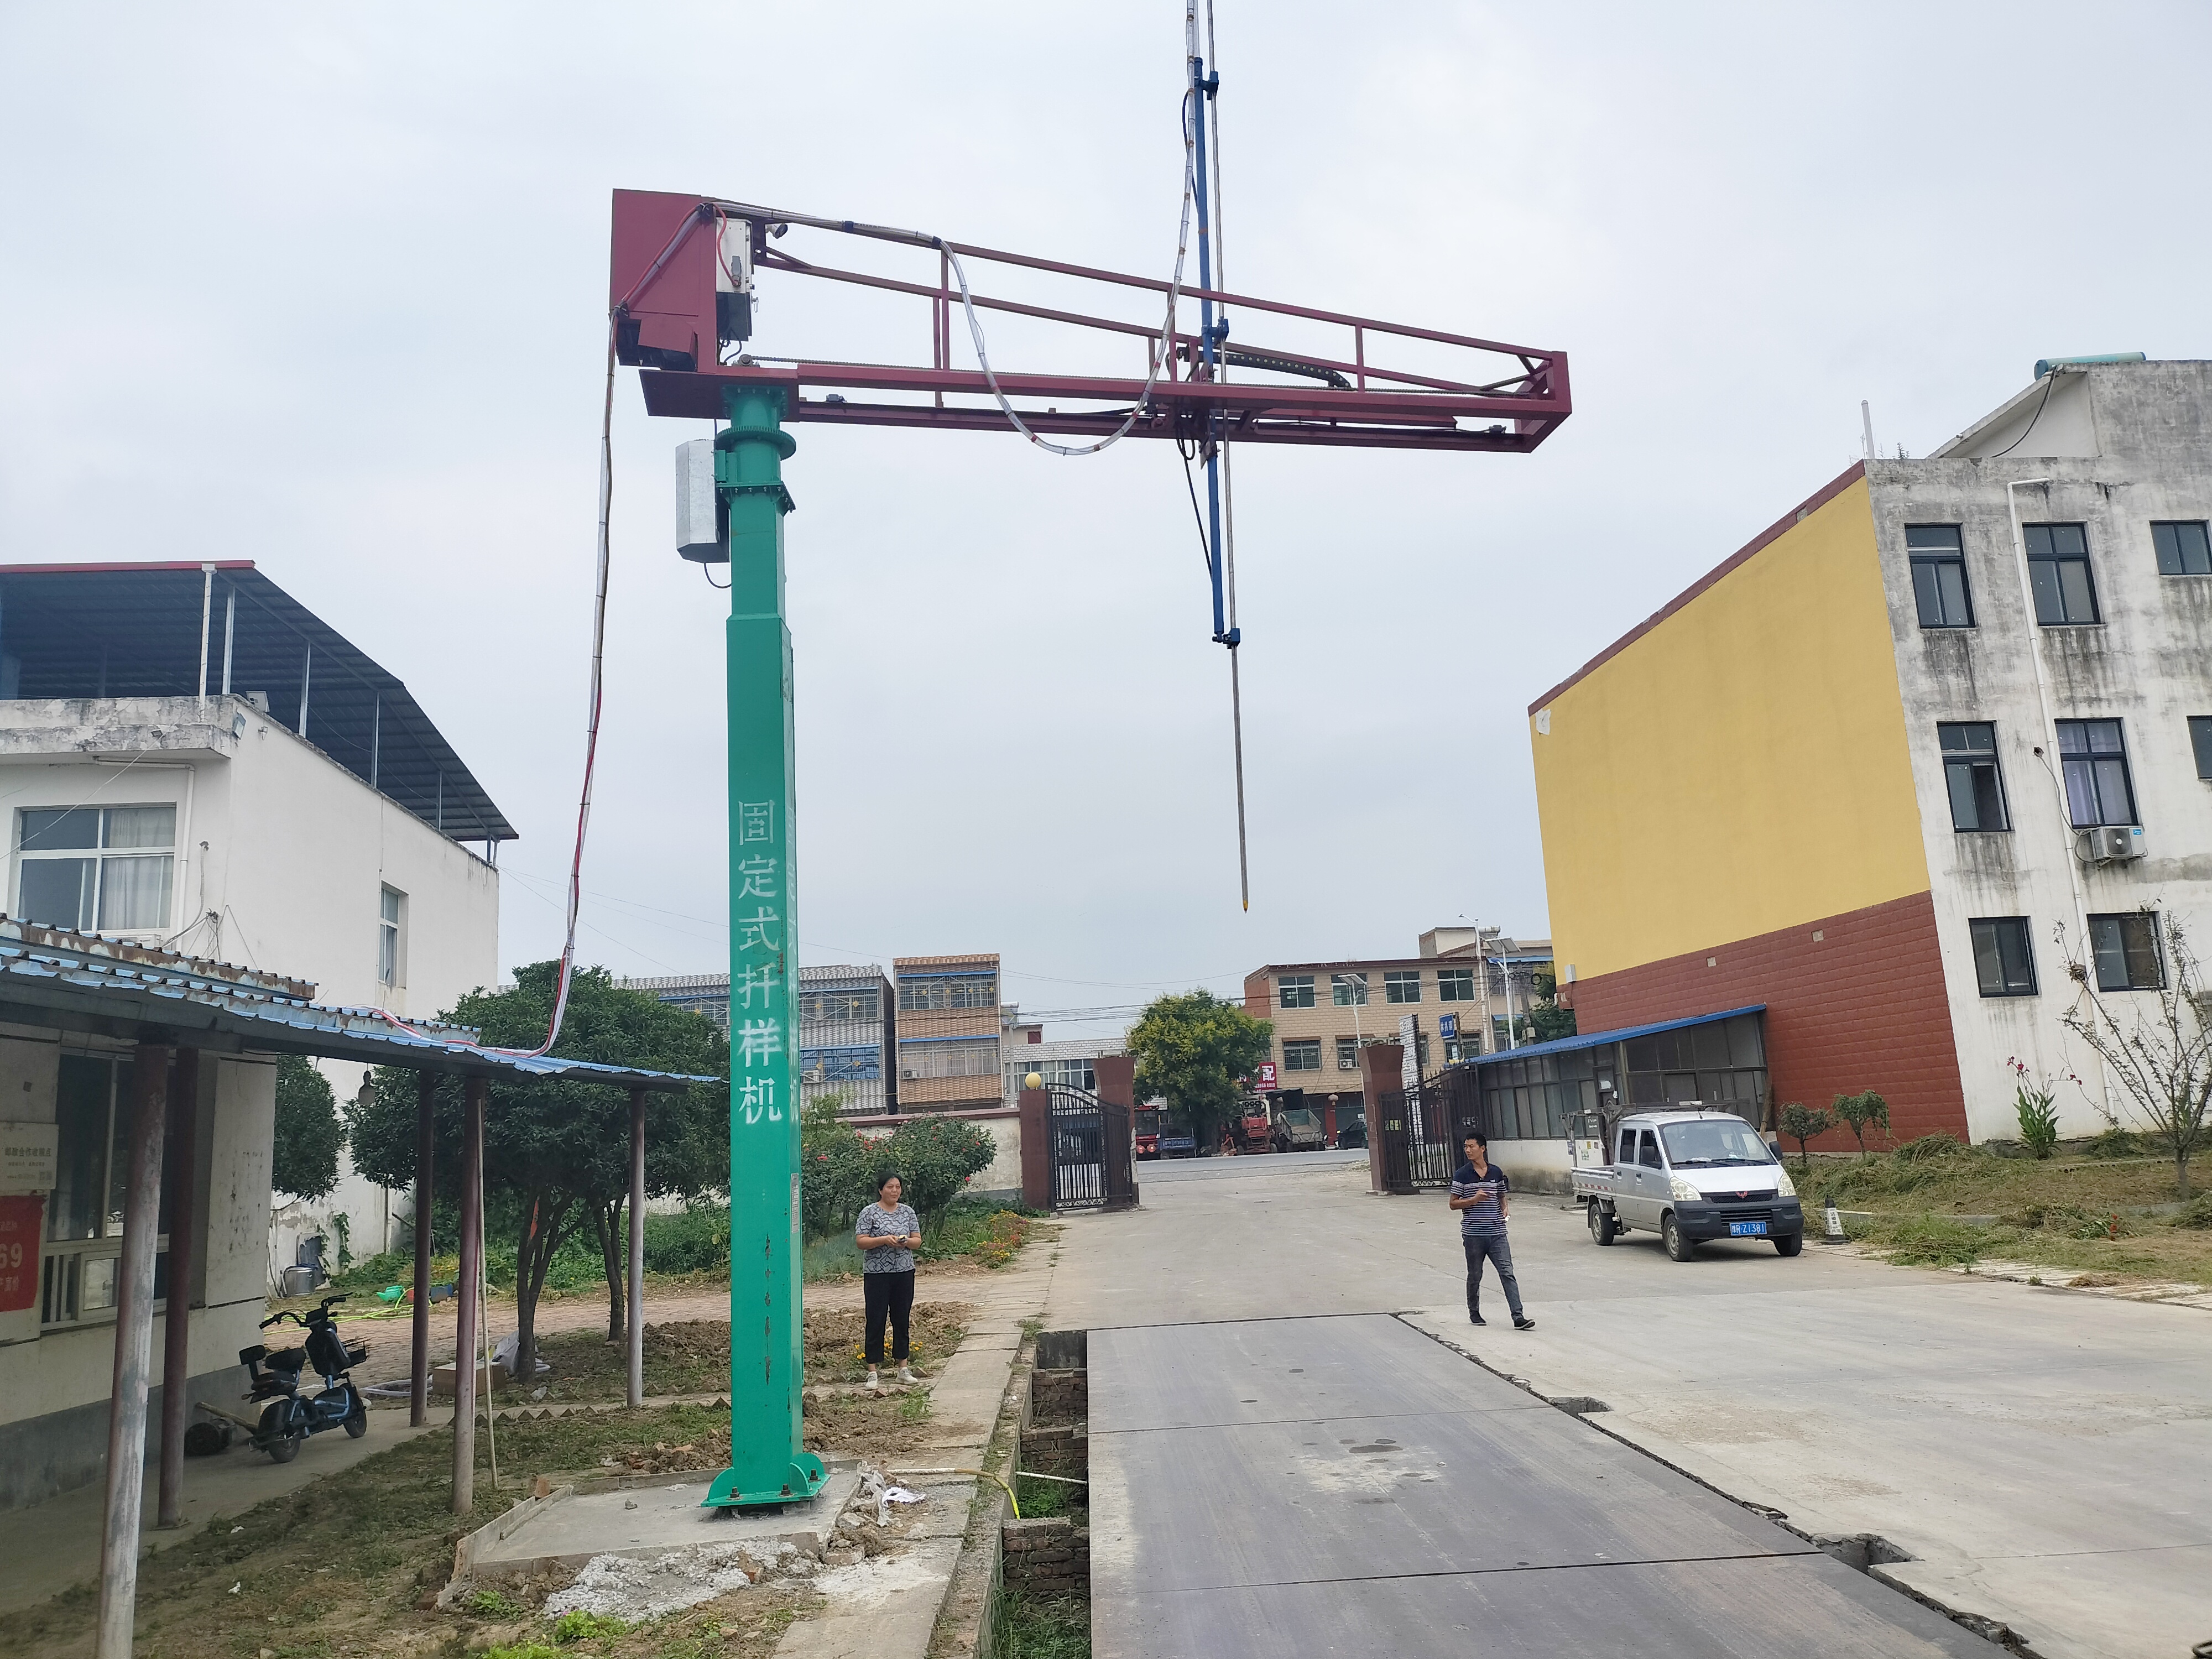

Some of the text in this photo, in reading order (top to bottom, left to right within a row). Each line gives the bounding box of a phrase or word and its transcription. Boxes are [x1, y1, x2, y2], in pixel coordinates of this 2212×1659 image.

[738, 800, 782, 1124] 固定式扦样机
